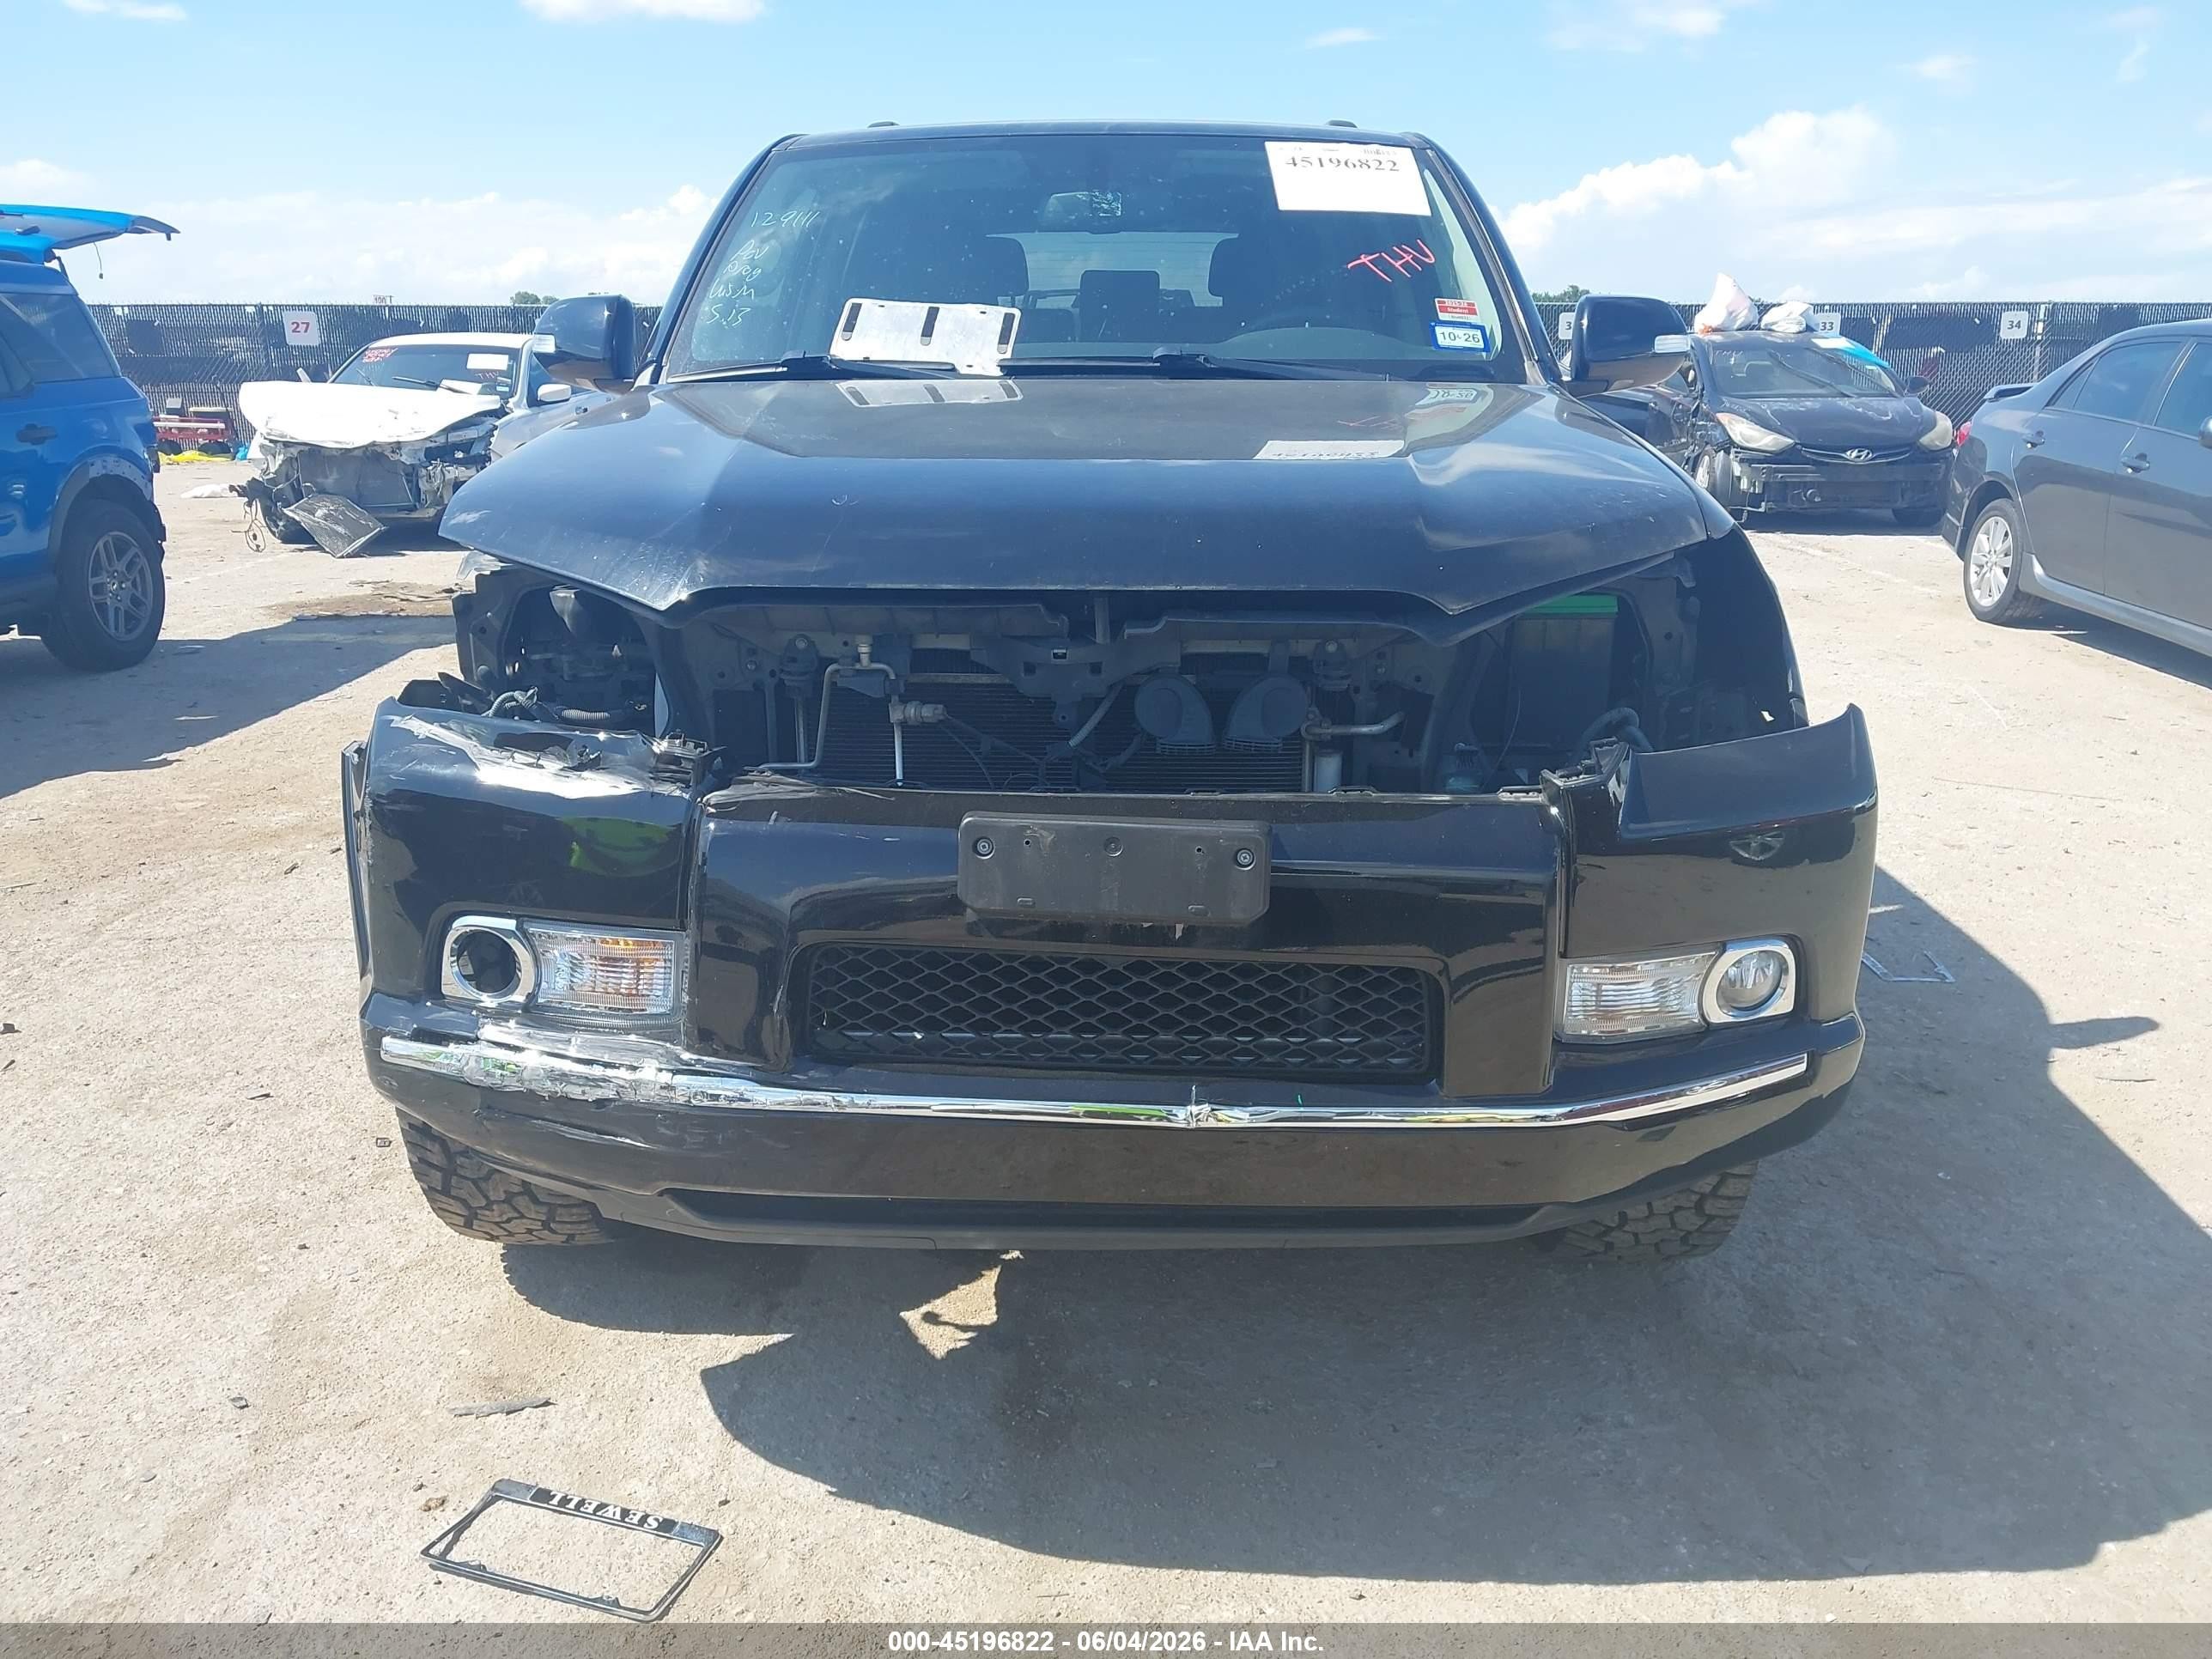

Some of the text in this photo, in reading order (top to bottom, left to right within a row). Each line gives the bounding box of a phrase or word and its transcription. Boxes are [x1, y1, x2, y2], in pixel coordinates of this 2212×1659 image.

[1285, 156, 1401, 173] 45196822
[1346, 239, 1437, 283] THU
[290, 321, 311, 334] 27
[1820, 321, 1834, 331] 33
[2007, 319, 2022, 330] 34
[548, 1489, 664, 1531] SEWELL
